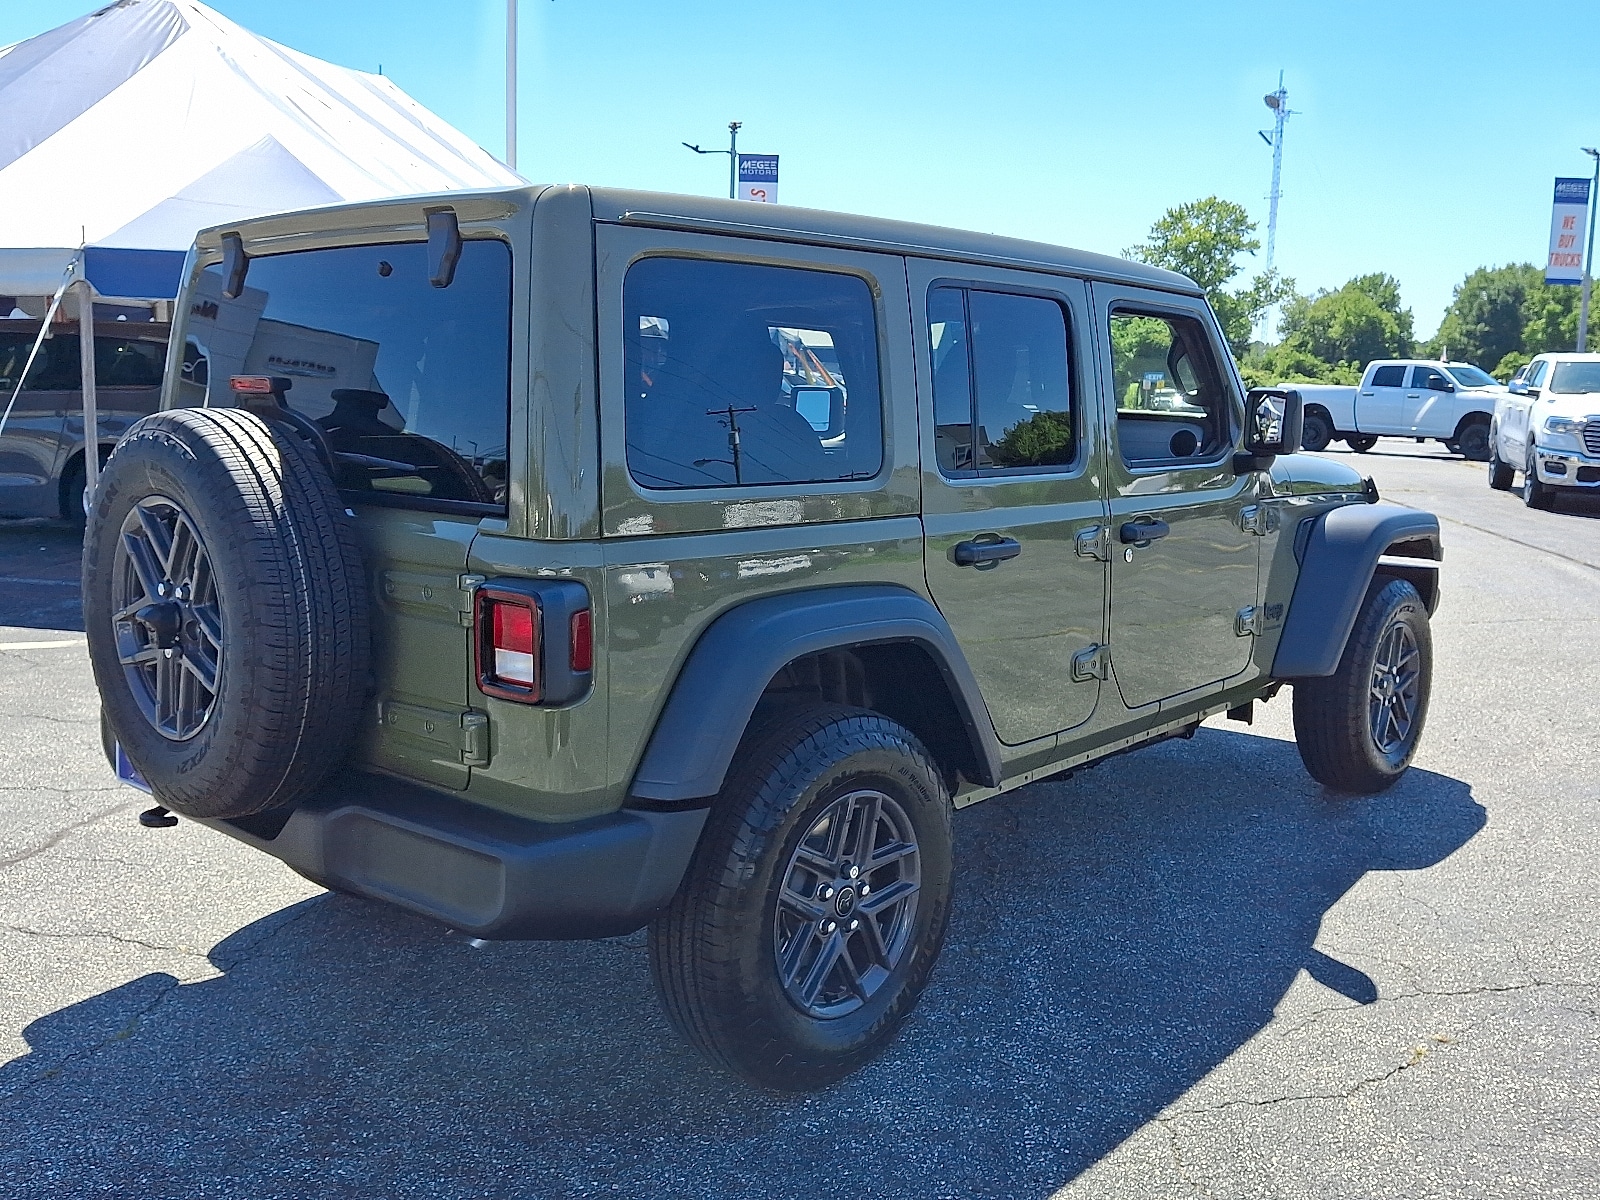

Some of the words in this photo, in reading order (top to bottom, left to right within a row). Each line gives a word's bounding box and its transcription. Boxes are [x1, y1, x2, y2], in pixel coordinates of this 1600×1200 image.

[740, 160, 777, 169] MEGEE
[1555, 183, 1589, 193] MEGEE
[1562, 215, 1576, 230] WE
[1558, 234, 1576, 249] BUY
[1549, 252, 1582, 267] TRUCKS
